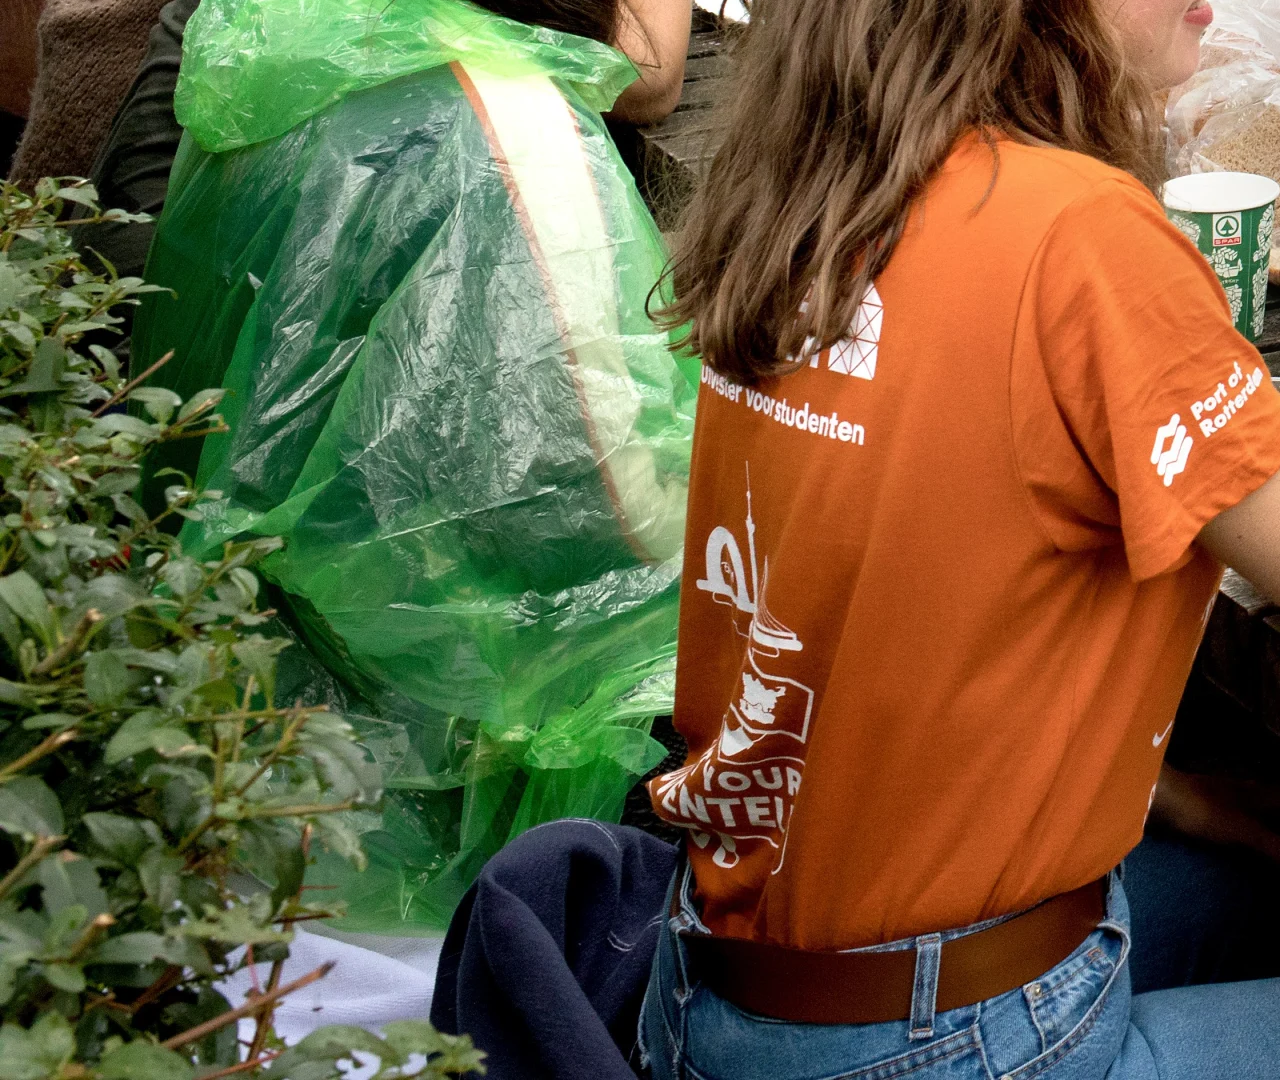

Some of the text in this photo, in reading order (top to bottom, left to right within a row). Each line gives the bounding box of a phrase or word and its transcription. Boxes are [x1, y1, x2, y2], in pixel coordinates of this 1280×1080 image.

[1214, 237, 1241, 245] SPAR
[1189, 360, 1243, 421] Port of
[745, 387, 776, 417] voor
[773, 397, 866, 446] studenten
[703, 766, 803, 797] YOUR
